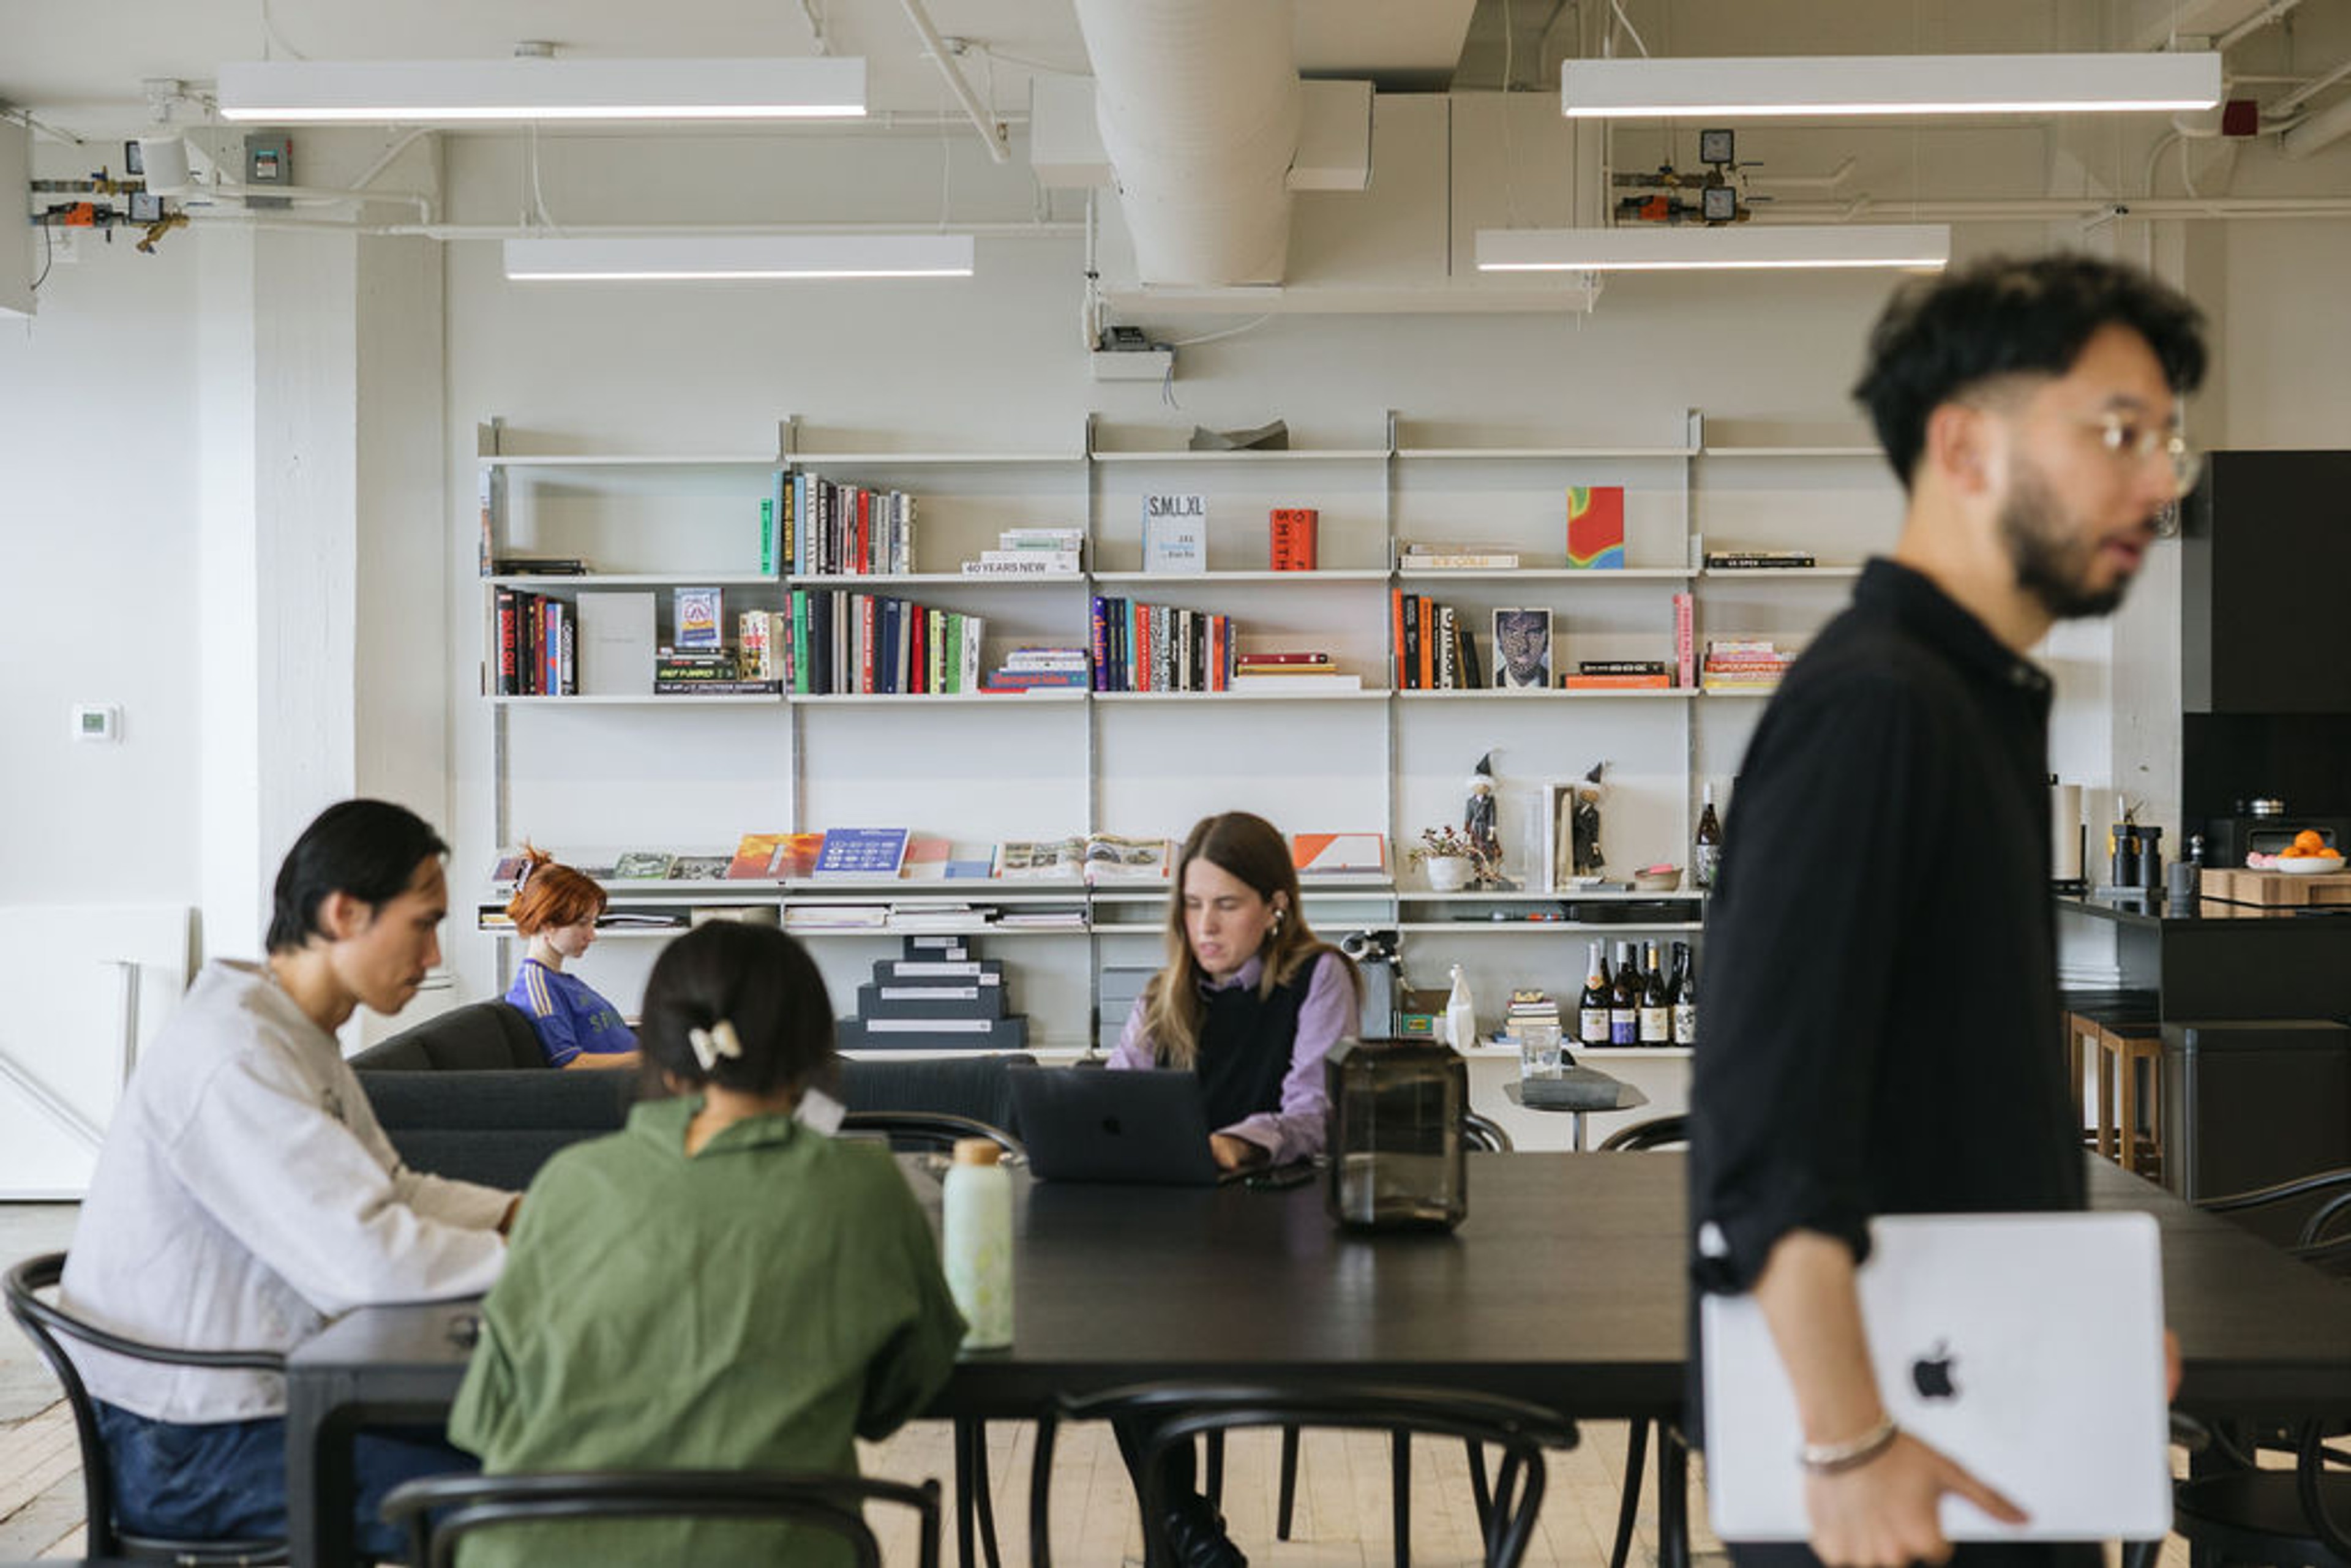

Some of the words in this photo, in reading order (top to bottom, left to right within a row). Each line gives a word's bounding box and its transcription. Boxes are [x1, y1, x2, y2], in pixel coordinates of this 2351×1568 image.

[982, 562, 1018, 572] YEARS
[1019, 562, 1046, 572] NEW
[502, 610, 515, 649] SOLD
[501, 651, 515, 677] OUT
